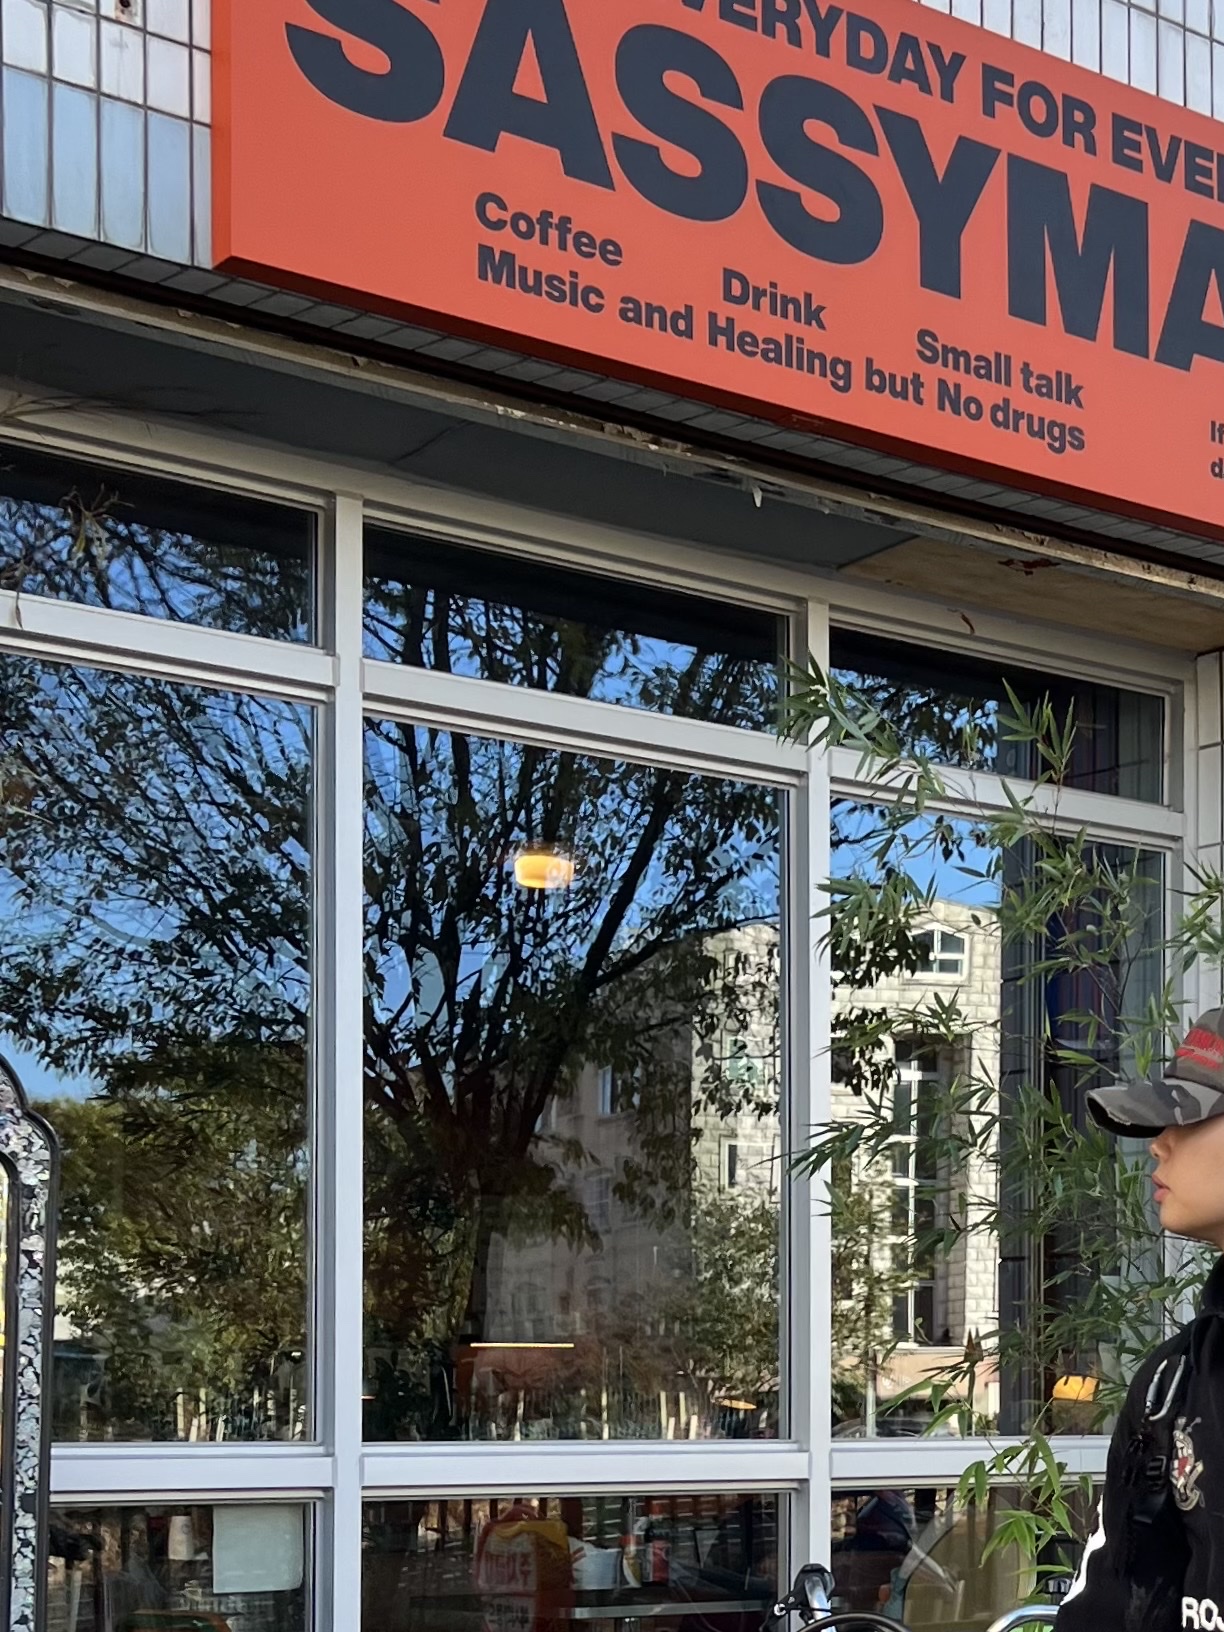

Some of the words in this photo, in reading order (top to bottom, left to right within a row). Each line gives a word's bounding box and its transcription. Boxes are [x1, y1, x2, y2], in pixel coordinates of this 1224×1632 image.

[982, 63, 1097, 157] FOR
[474, 192, 623, 266] Coffee
[722, 268, 826, 331] Drink
[477, 244, 605, 313] Music
[619, 291, 694, 342] and
[707, 310, 853, 393] Healing
[864, 357, 925, 408] but
[936, 382, 983, 422] No
[989, 394, 1085, 455] drugs
[915, 329, 1013, 387] Small
[1021, 358, 1085, 410] talk
